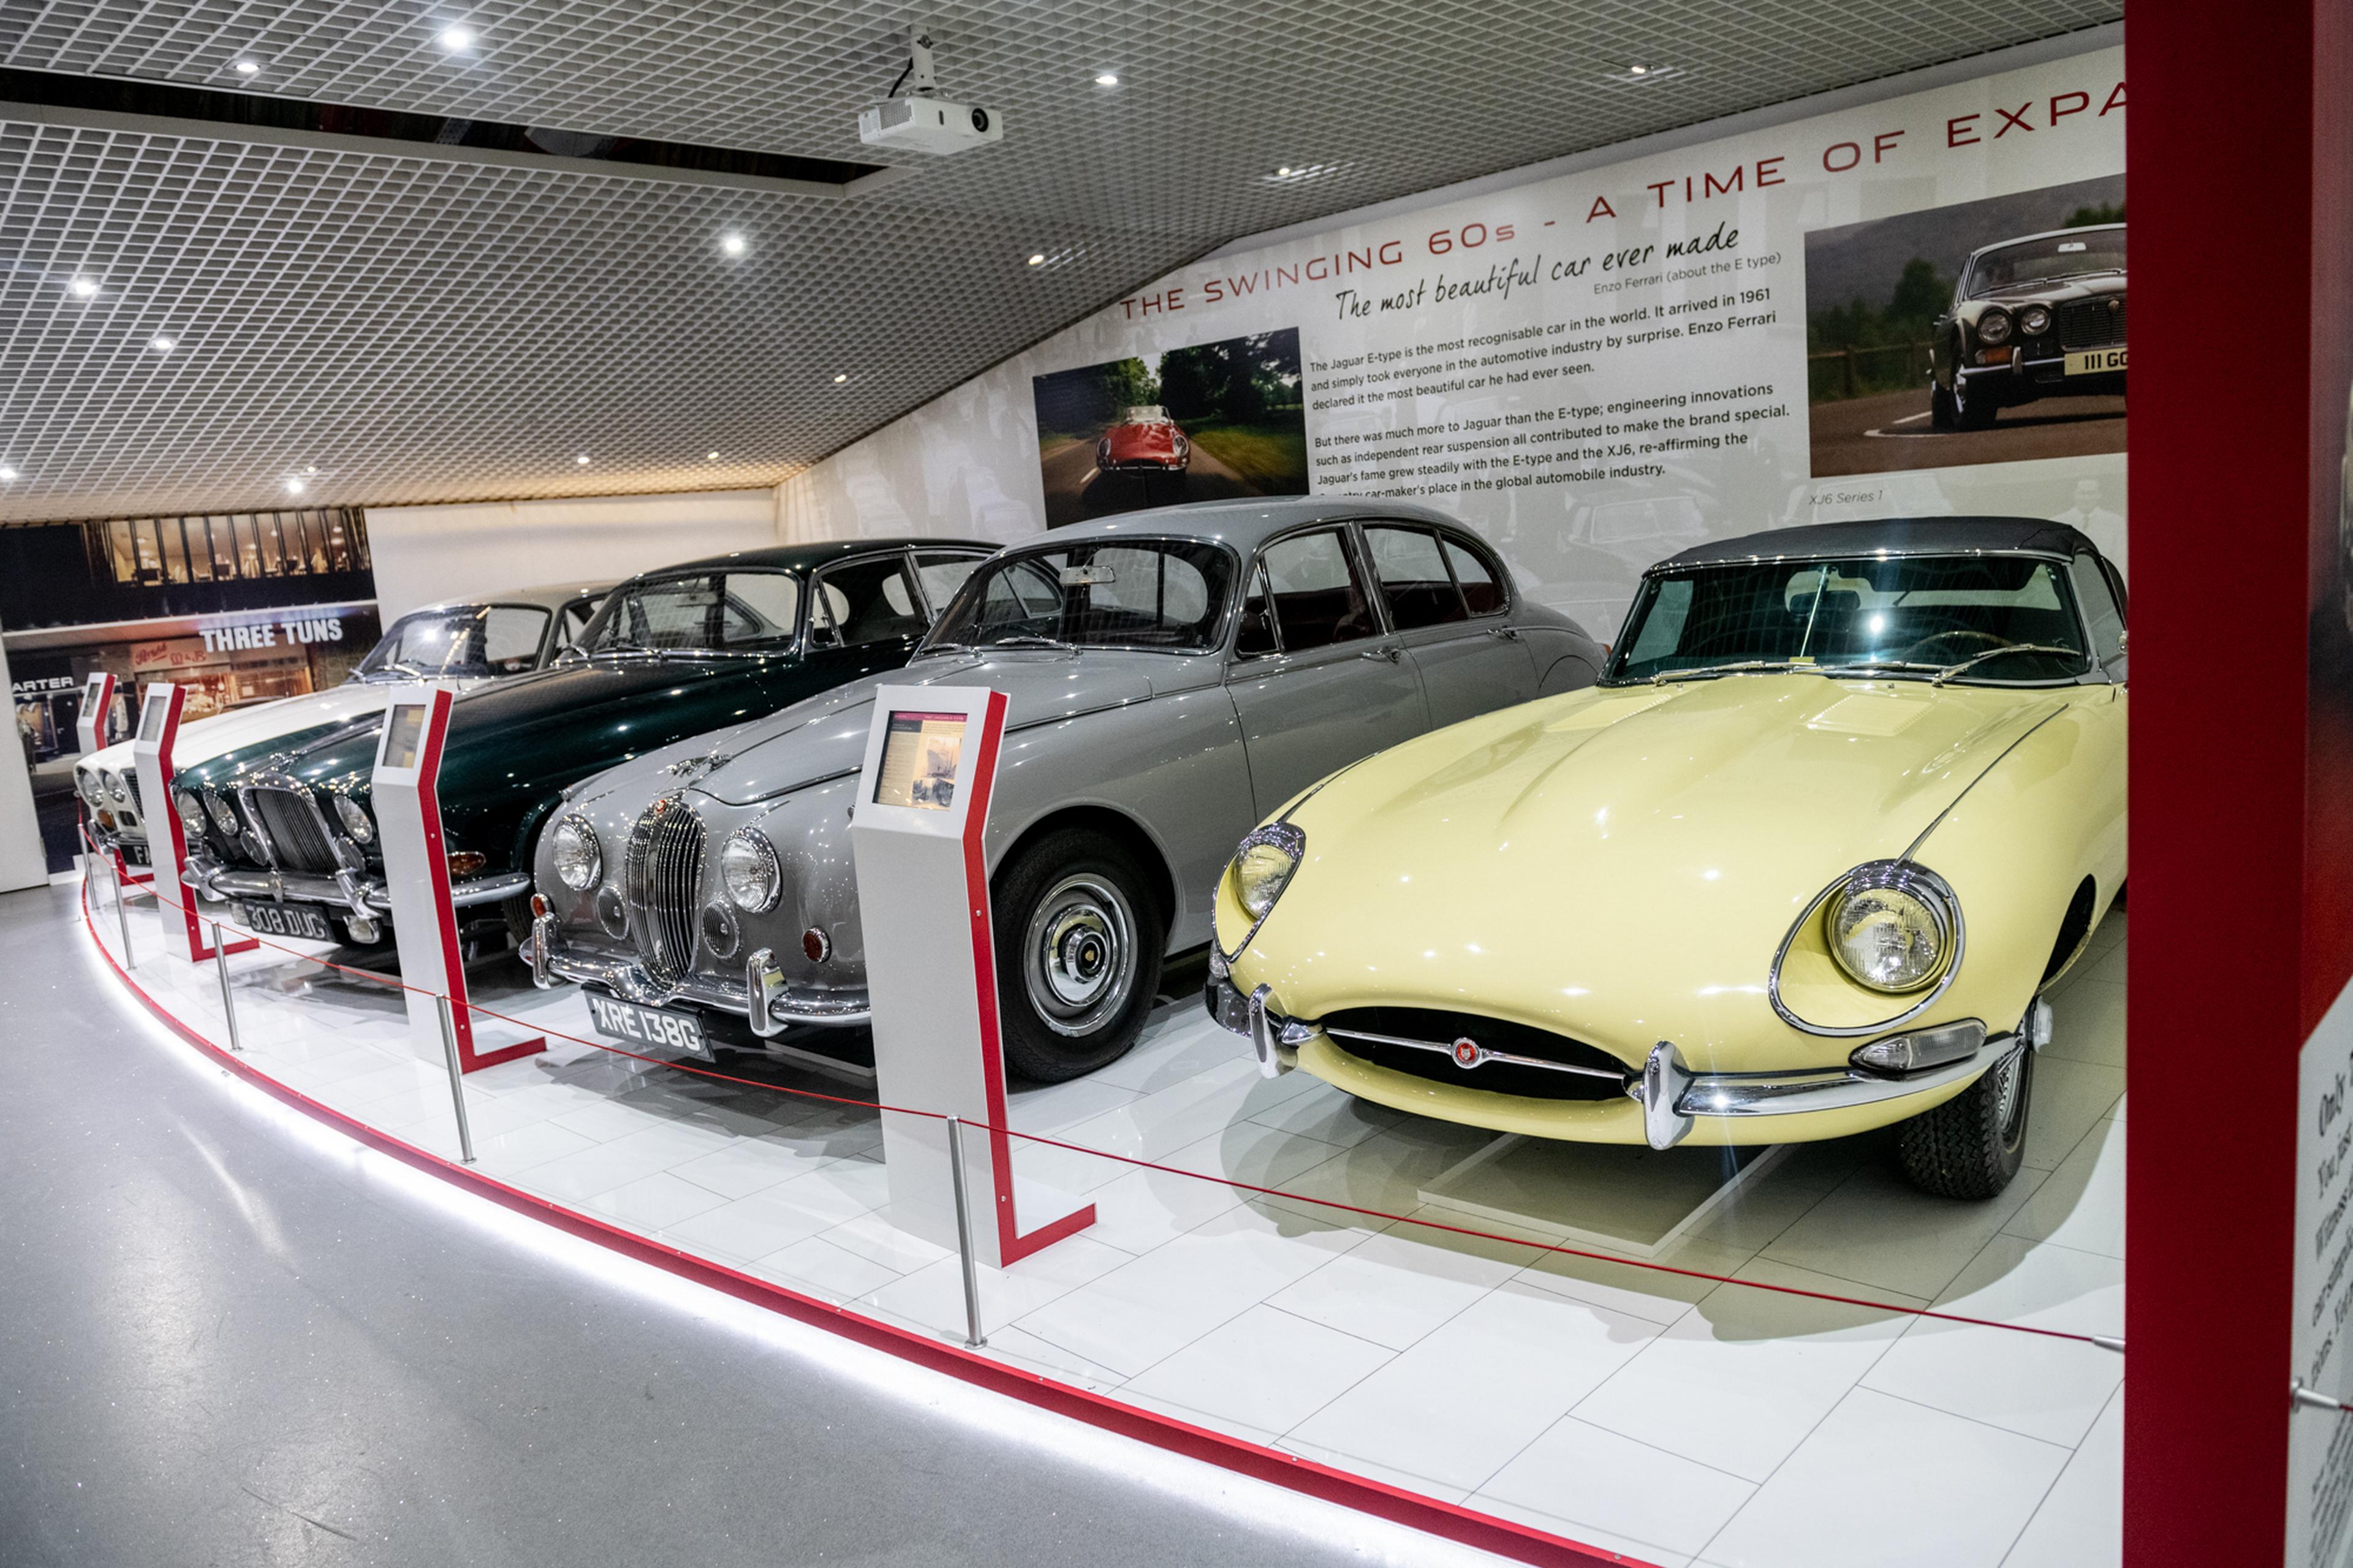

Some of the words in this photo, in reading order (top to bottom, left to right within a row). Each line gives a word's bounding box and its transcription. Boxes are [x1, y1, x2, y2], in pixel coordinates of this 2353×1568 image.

[1120, 289, 1184, 320] THE
[1204, 240, 1403, 303] SWINGING
[1428, 223, 1515, 255] 60s
[1586, 196, 1617, 224] A
[1647, 156, 1786, 208] TIME
[1822, 130, 1905, 173] OF
[1335, 290, 1371, 320] The
[1381, 277, 1427, 312] most
[1435, 254, 1540, 304] beautiful
[1551, 257, 1591, 281] car
[1602, 244, 1654, 271] ever
[1665, 221, 1740, 259] made
[1594, 282, 1622, 295] Enzo
[1625, 272, 1663, 289] Ferrari
[1666, 265, 1707, 283] (about
[1711, 262, 1731, 275] the
[1735, 257, 1743, 270] E
[1746, 251, 1781, 270] type)
[1309, 362, 1328, 372] The
[1331, 357, 1364, 369] Jaguar
[1367, 350, 1402, 364] E-type
[1404, 347, 1413, 357] is
[1415, 344, 1434, 356] the
[1437, 338, 1464, 352] most
[1468, 325, 1543, 347] recognisable
[1547, 324, 1566, 335] car
[1570, 319, 1581, 331] in
[1585, 316, 1605, 329] the
[1609, 307, 1651, 325] world.
[1654, 305, 1664, 317] It
[1669, 295, 1718, 316] arrived
[1722, 294, 1735, 307] in
[1740, 287, 1770, 304] 1961
[1311, 379, 1330, 392] and
[1332, 374, 1364, 388] simply
[1367, 370, 1390, 384] took
[1393, 364, 1442, 379] everyone
[1446, 360, 1456, 371] in
[1458, 358, 1477, 369] the
[1480, 347, 1548, 366] automotive
[1552, 339, 1602, 355] industry
[1607, 336, 1623, 349] by
[1626, 327, 1684, 345] surprise.
[1688, 321, 1723, 335] Enzo
[1728, 310, 1776, 330] Ferrari
[1312, 394, 1355, 411] declared
[1357, 393, 1365, 404] it
[1367, 392, 1384, 403] the
[1387, 387, 1413, 400] most
[1416, 379, 1464, 396] beautiful
[1468, 378, 1486, 389] car
[1489, 374, 1503, 386] he
[1506, 369, 1529, 384] had
[1532, 368, 1559, 380] ever
[1562, 363, 1594, 376] seen.
[1315, 437, 1332, 448] But
[1334, 434, 1360, 445] there
[1363, 432, 1382, 442] was
[1385, 426, 1414, 439] much
[1417, 425, 1445, 436] more
[1447, 422, 1460, 432] to
[1463, 418, 1502, 430] Jaguar
[1505, 414, 1531, 425] than
[1534, 410, 1555, 421] the
[1558, 405, 1603, 419] E-type;
[1607, 394, 1686, 412] engineering
[1691, 385, 1773, 404] innovations
[1316, 455, 1339, 466] such
[1341, 455, 1352, 464] as
[1354, 446, 1419, 463] independent
[1422, 444, 1444, 455] rear
[1447, 436, 1510, 453] suspension
[1512, 433, 1527, 445] all
[1530, 424, 1602, 444] contributed
[1605, 424, 1620, 435] to
[1623, 419, 1659, 433] make
[1662, 417, 1685, 430] the
[1689, 410, 1730, 426] brand
[1735, 404, 1790, 422] special.
[1360, 470, 1386, 481] fame
[1389, 468, 1414, 480] grew
[1417, 461, 1460, 476] steadily
[1463, 458, 1488, 471] with
[1490, 456, 1510, 468] the
[1513, 453, 1553, 467] E-type
[1556, 449, 1578, 462] and
[1582, 447, 1604, 460] the
[1607, 443, 1635, 458] XJ6,
[1639, 436, 1720, 454] re-affirming
[1724, 432, 1748, 445] the
[1428, 482, 1457, 496] place
[1461, 480, 1471, 491] in
[1474, 479, 1493, 490] the
[1495, 474, 1532, 490] global
[1536, 468, 1605, 485] automobile
[1609, 464, 1665, 479] industry.
[1808, 493, 1833, 506] XJ6
[1836, 492, 1875, 504] Series
[1878, 491, 1883, 501] 1
[199, 623, 276, 653] THREE
[281, 618, 343, 645] TUNS
[12, 676, 74, 692] ARTER
[592, 998, 642, 1038] XRE
[638, 1011, 700, 1051] 138G
[2319, 1072, 2346, 1137] Only
